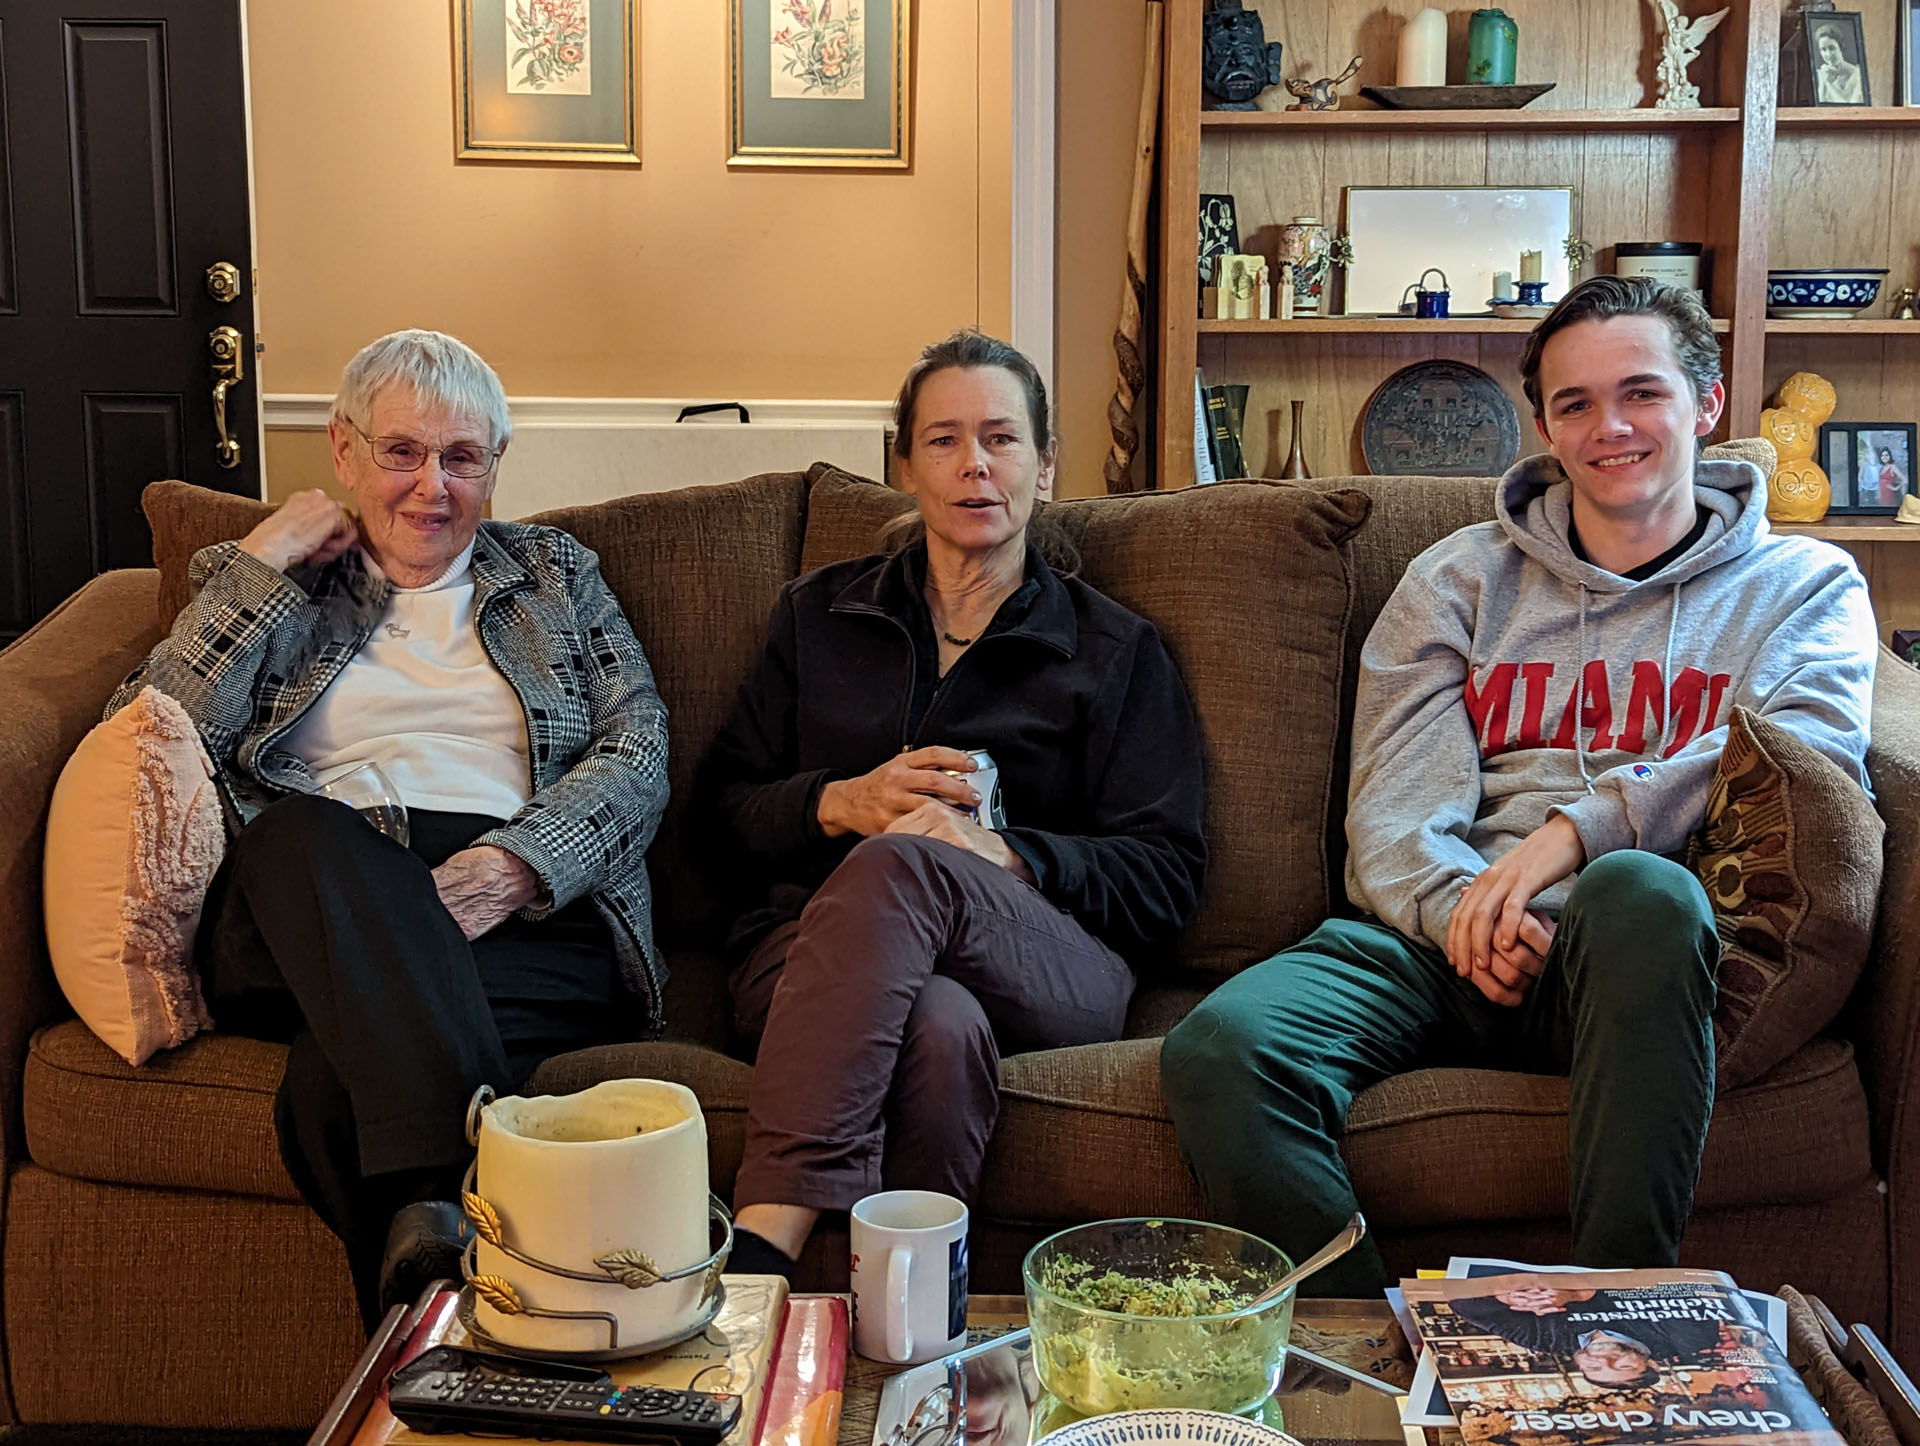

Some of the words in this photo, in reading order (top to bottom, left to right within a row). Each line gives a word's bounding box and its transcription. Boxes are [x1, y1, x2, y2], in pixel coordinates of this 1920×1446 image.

[1465, 660, 1732, 758] MIAMI
[1567, 1309, 1736, 1323] Winchester
[1614, 1299, 1727, 1311] Rebirth
[1510, 1409, 1653, 1432] chaser
[1664, 1404, 1792, 1432] chevy
